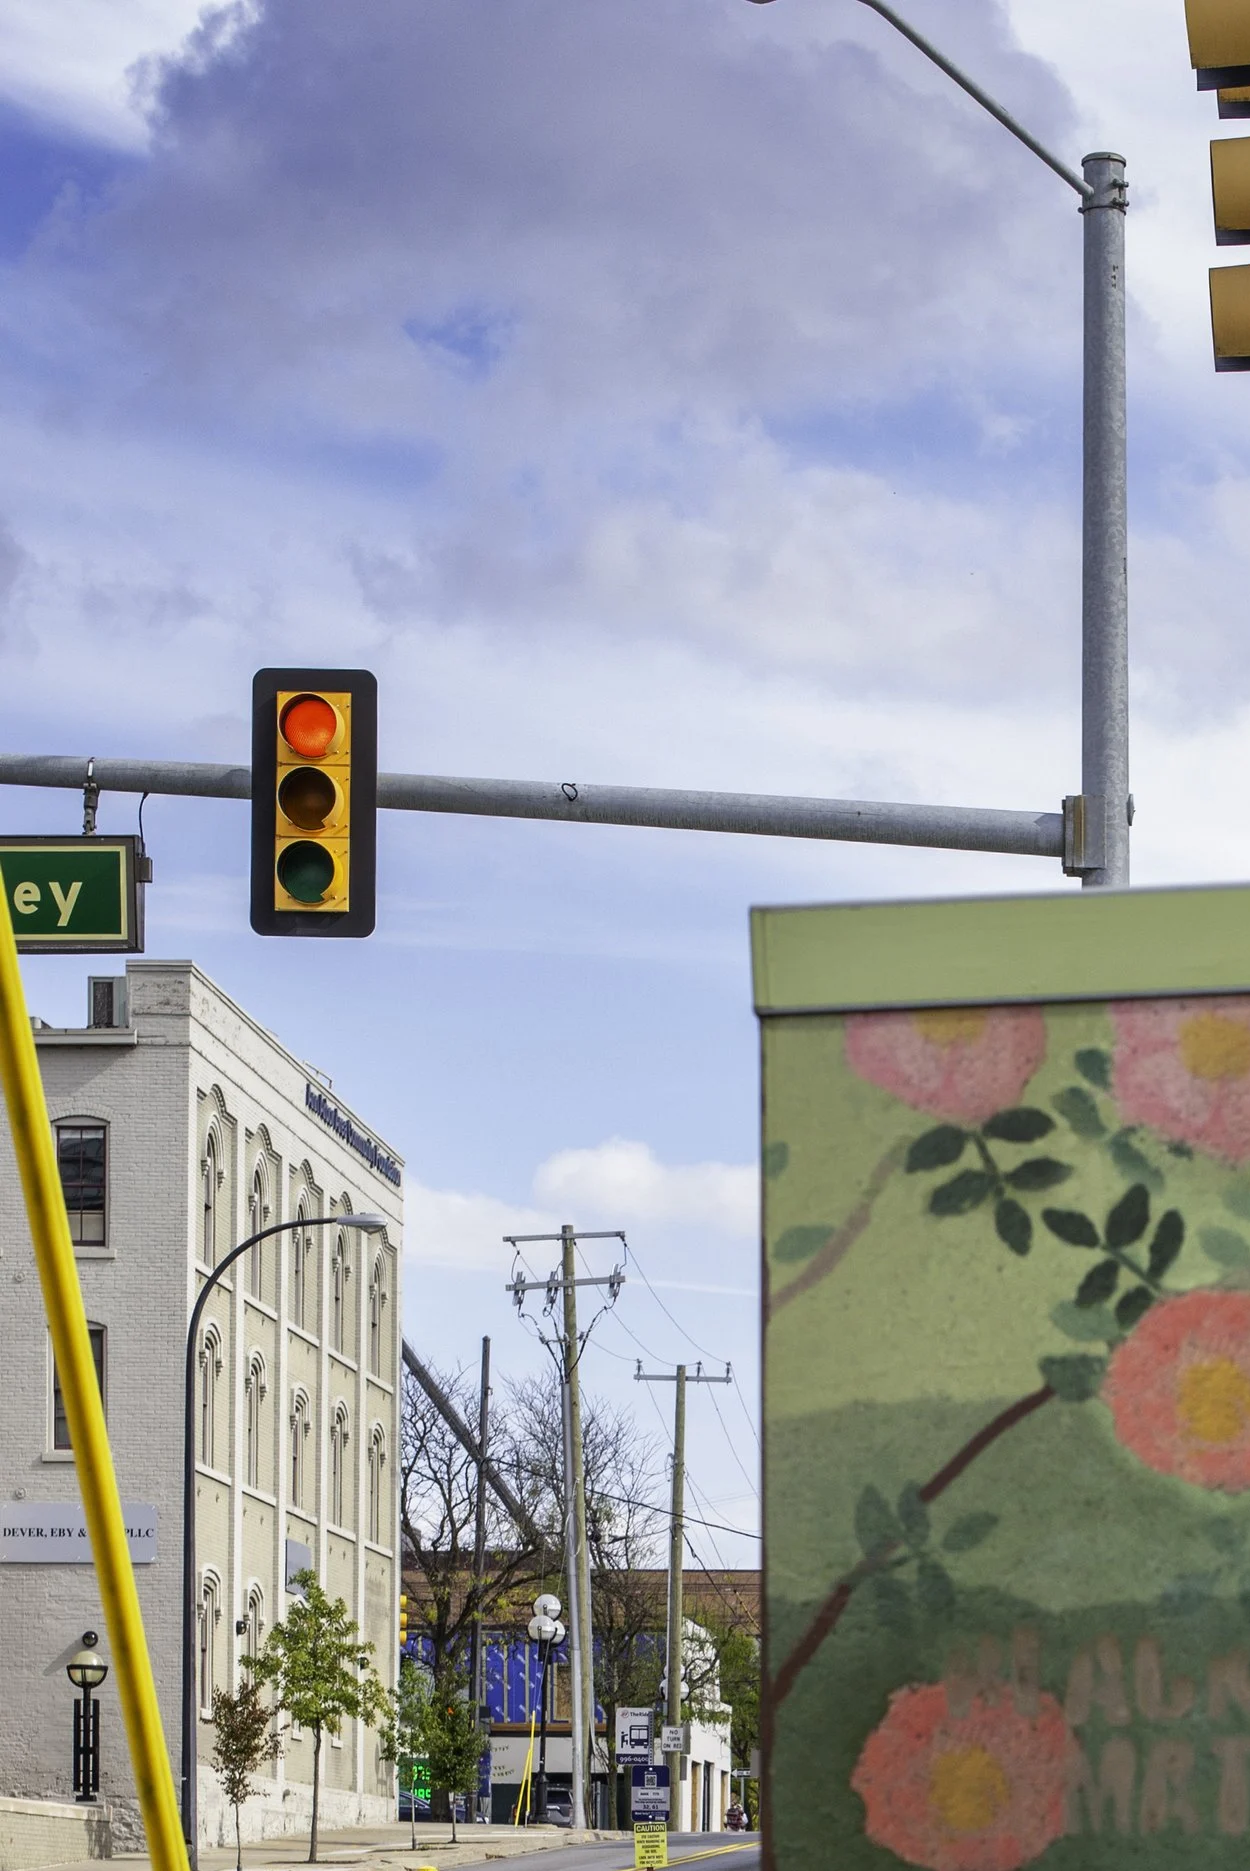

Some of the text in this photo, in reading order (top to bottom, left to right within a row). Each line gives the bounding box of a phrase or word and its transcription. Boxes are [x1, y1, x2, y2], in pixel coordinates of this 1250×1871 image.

[3, 1527, 48, 1538] DEVER,
[50, 1527, 74, 1538] EBY
[77, 1528, 87, 1538] &
